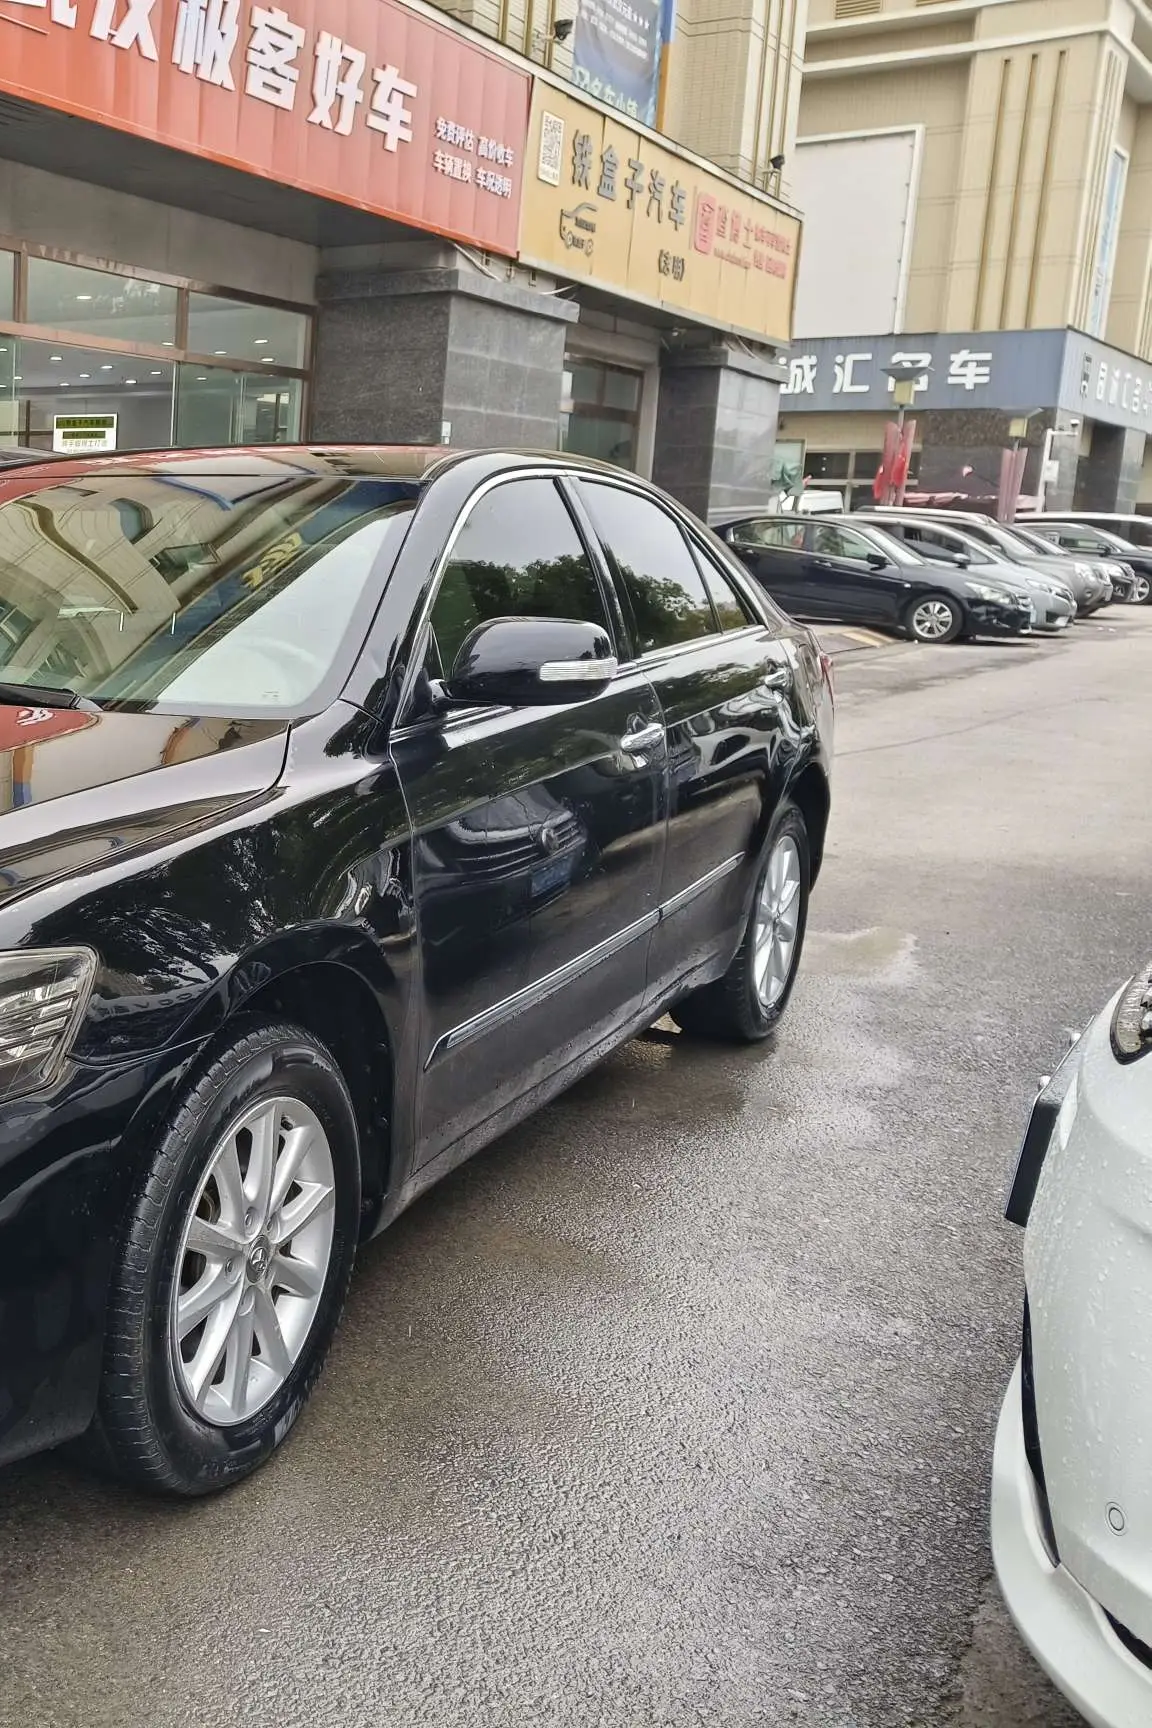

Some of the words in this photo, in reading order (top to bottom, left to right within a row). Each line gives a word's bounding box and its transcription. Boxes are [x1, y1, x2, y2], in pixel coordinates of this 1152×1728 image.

[4, 0, 417, 152] 汉极客好车
